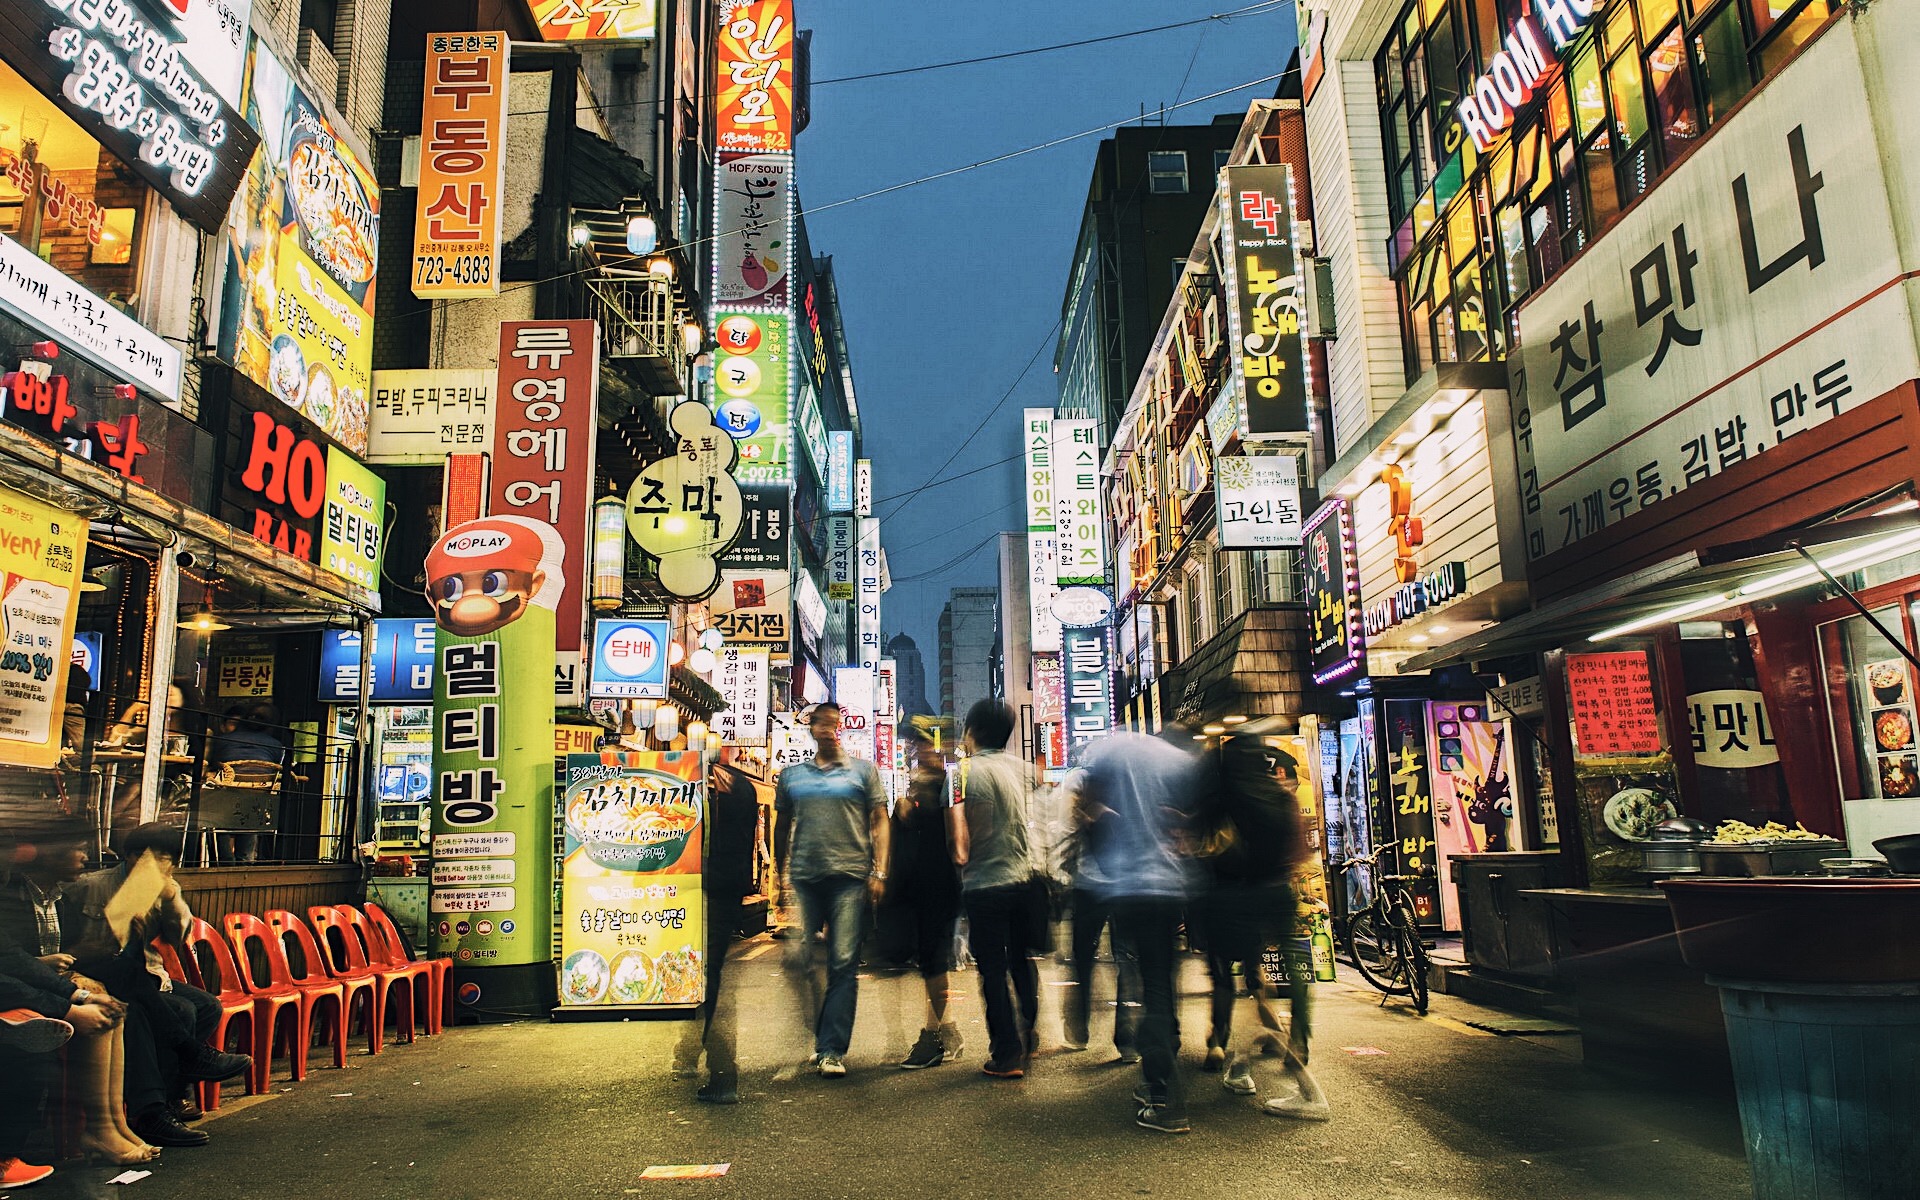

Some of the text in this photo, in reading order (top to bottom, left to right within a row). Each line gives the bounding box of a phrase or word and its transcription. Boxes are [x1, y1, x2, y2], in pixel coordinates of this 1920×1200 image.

[432, 36, 499, 53] 종로한국
[1458, 15, 1548, 154] ROOM
[424, 56, 493, 241] 부동산
[729, 164, 784, 174] HOF/SOJU
[5, 154, 107, 247] 주는 냉면집
[302, 145, 373, 241] 김치찌개
[1240, 191, 1281, 237] 락
[1239, 238, 1287, 248] Happy Rock
[416, 255, 491, 285] 723-4383
[1549, 123, 1826, 432] 참맛나
[763, 293, 782, 308] 5F
[1243, 255, 1299, 398] 노래방
[125, 339, 164, 379] 공기밥
[327, 334, 347, 371] 냉면
[440, 424, 485, 444] 전문점
[504, 327, 574, 525] 류영헤어
[241, 410, 327, 519] HO
[680, 437, 717, 462] 종로
[1030, 419, 1052, 522] 테스트와이즈
[733, 465, 784, 480] 7-0073
[633, 476, 723, 539] 주막
[1073, 428, 1099, 565] 테스트와이즈
[1223, 499, 1298, 524] 고인돌
[253, 507, 313, 562] BAR
[327, 500, 380, 562] 멀티방
[1058, 499, 1073, 566] 시사영어학원
[1313, 588, 1345, 647] 노래방
[1363, 561, 1456, 637] ROOM HOF SOJU
[712, 613, 785, 638] 김치찜
[611, 640, 651, 658] 담배
[221, 665, 271, 688] 부동산
[605, 685, 649, 695] KTRA
[742, 661, 757, 726] 매운갈비찜
[441, 641, 505, 824] 멀티방
[554, 728, 593, 752] 담배
[570, 765, 624, 783] 38번가
[582, 781, 697, 812] 김치찌개
[1396, 745, 1436, 869] 노래방
[580, 907, 638, 933] 숯불갈비
[655, 907, 686, 929] 냉면
[1417, 896, 1429, 905] B1
